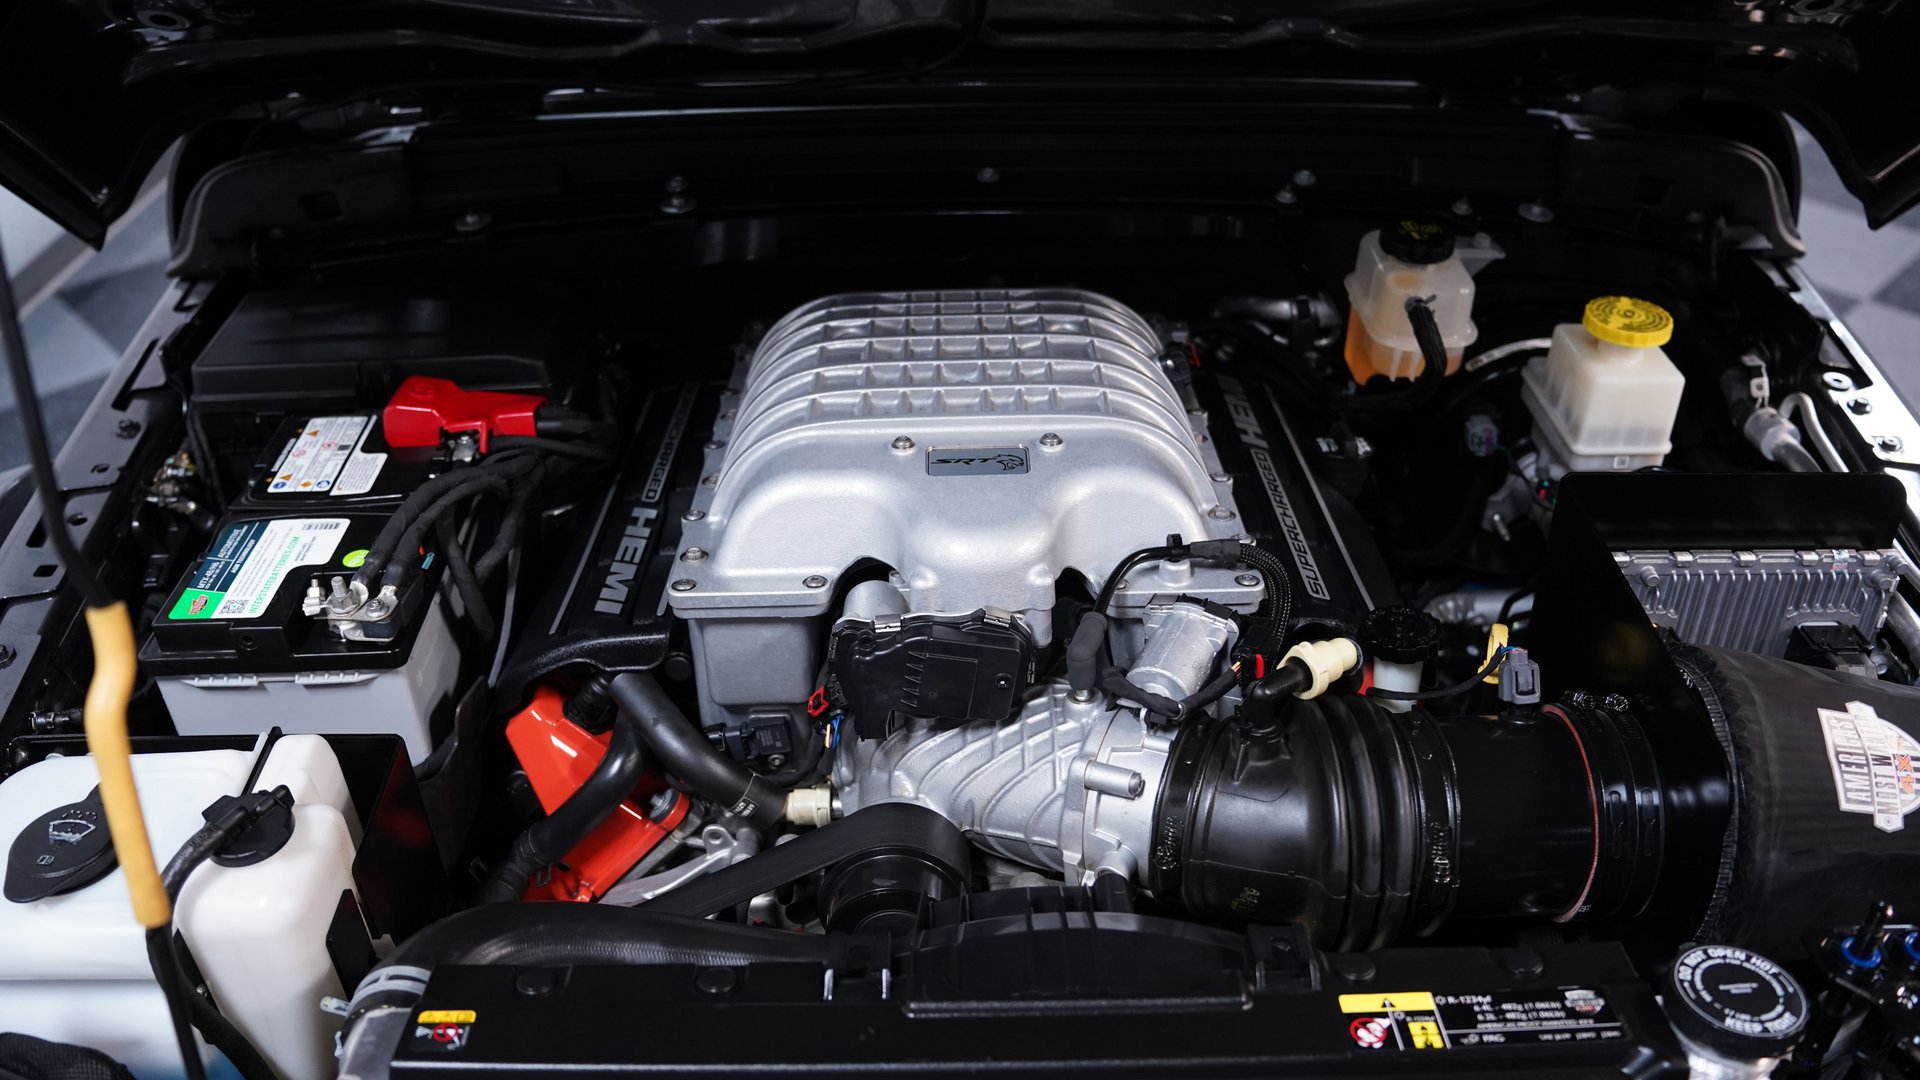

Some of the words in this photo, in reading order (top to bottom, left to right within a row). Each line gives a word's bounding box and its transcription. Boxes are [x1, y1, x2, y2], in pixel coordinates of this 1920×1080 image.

[930, 457, 998, 465] SRT
[1255, 451, 1326, 598] SUPERCHARGED
[594, 507, 659, 615] HEMI
[1874, 772, 1899, 815] MOST
[1707, 948, 1747, 961] OPEN
[1750, 956, 1780, 975] HOT
[1724, 1017, 1763, 1033] KEEP
